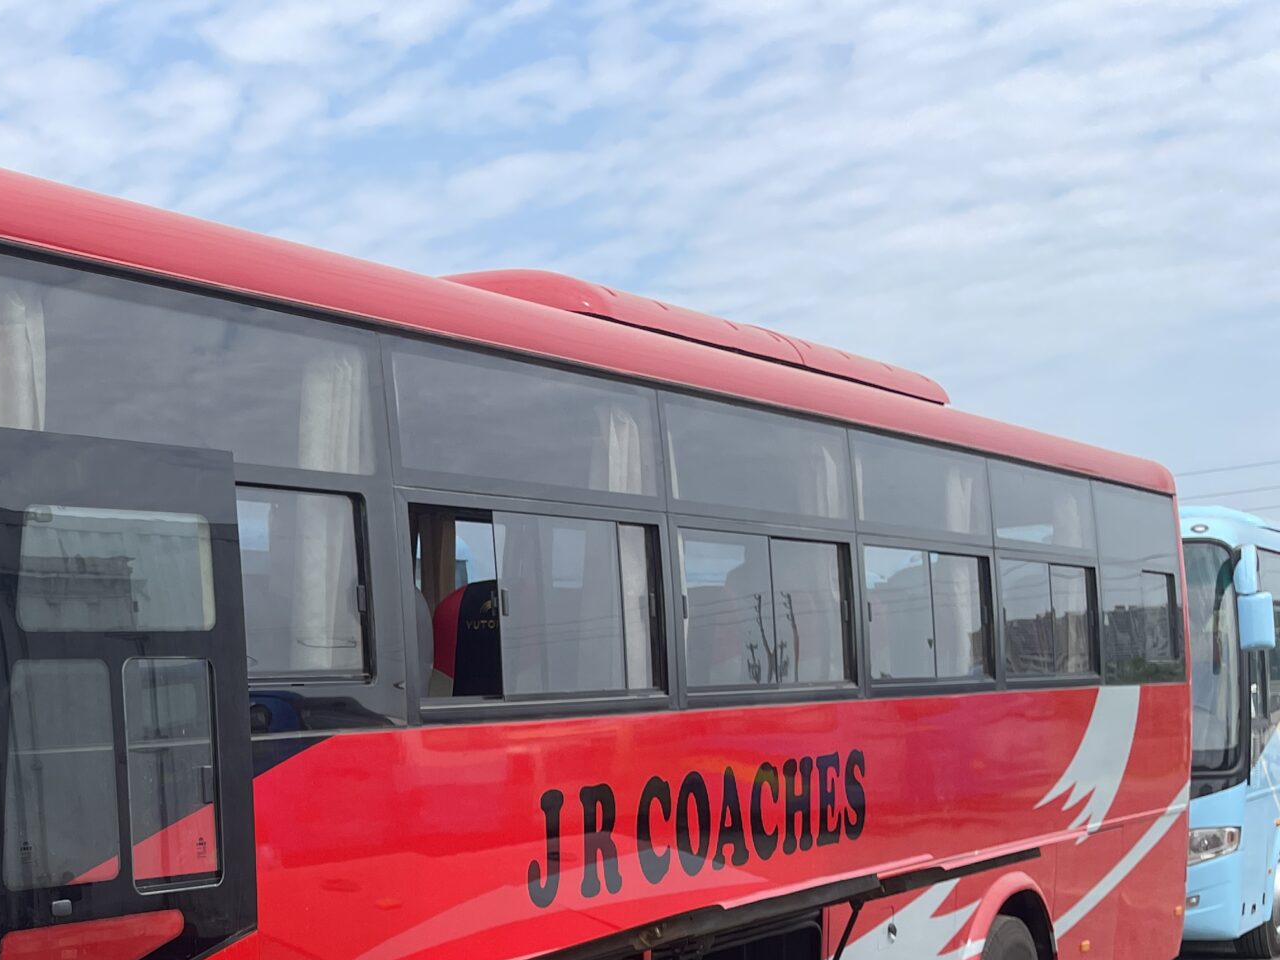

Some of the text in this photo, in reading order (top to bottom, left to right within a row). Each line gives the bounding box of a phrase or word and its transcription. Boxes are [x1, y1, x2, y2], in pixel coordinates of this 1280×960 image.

[466, 619, 499, 630] YUTO
[528, 749, 866, 908] J R COACHES
